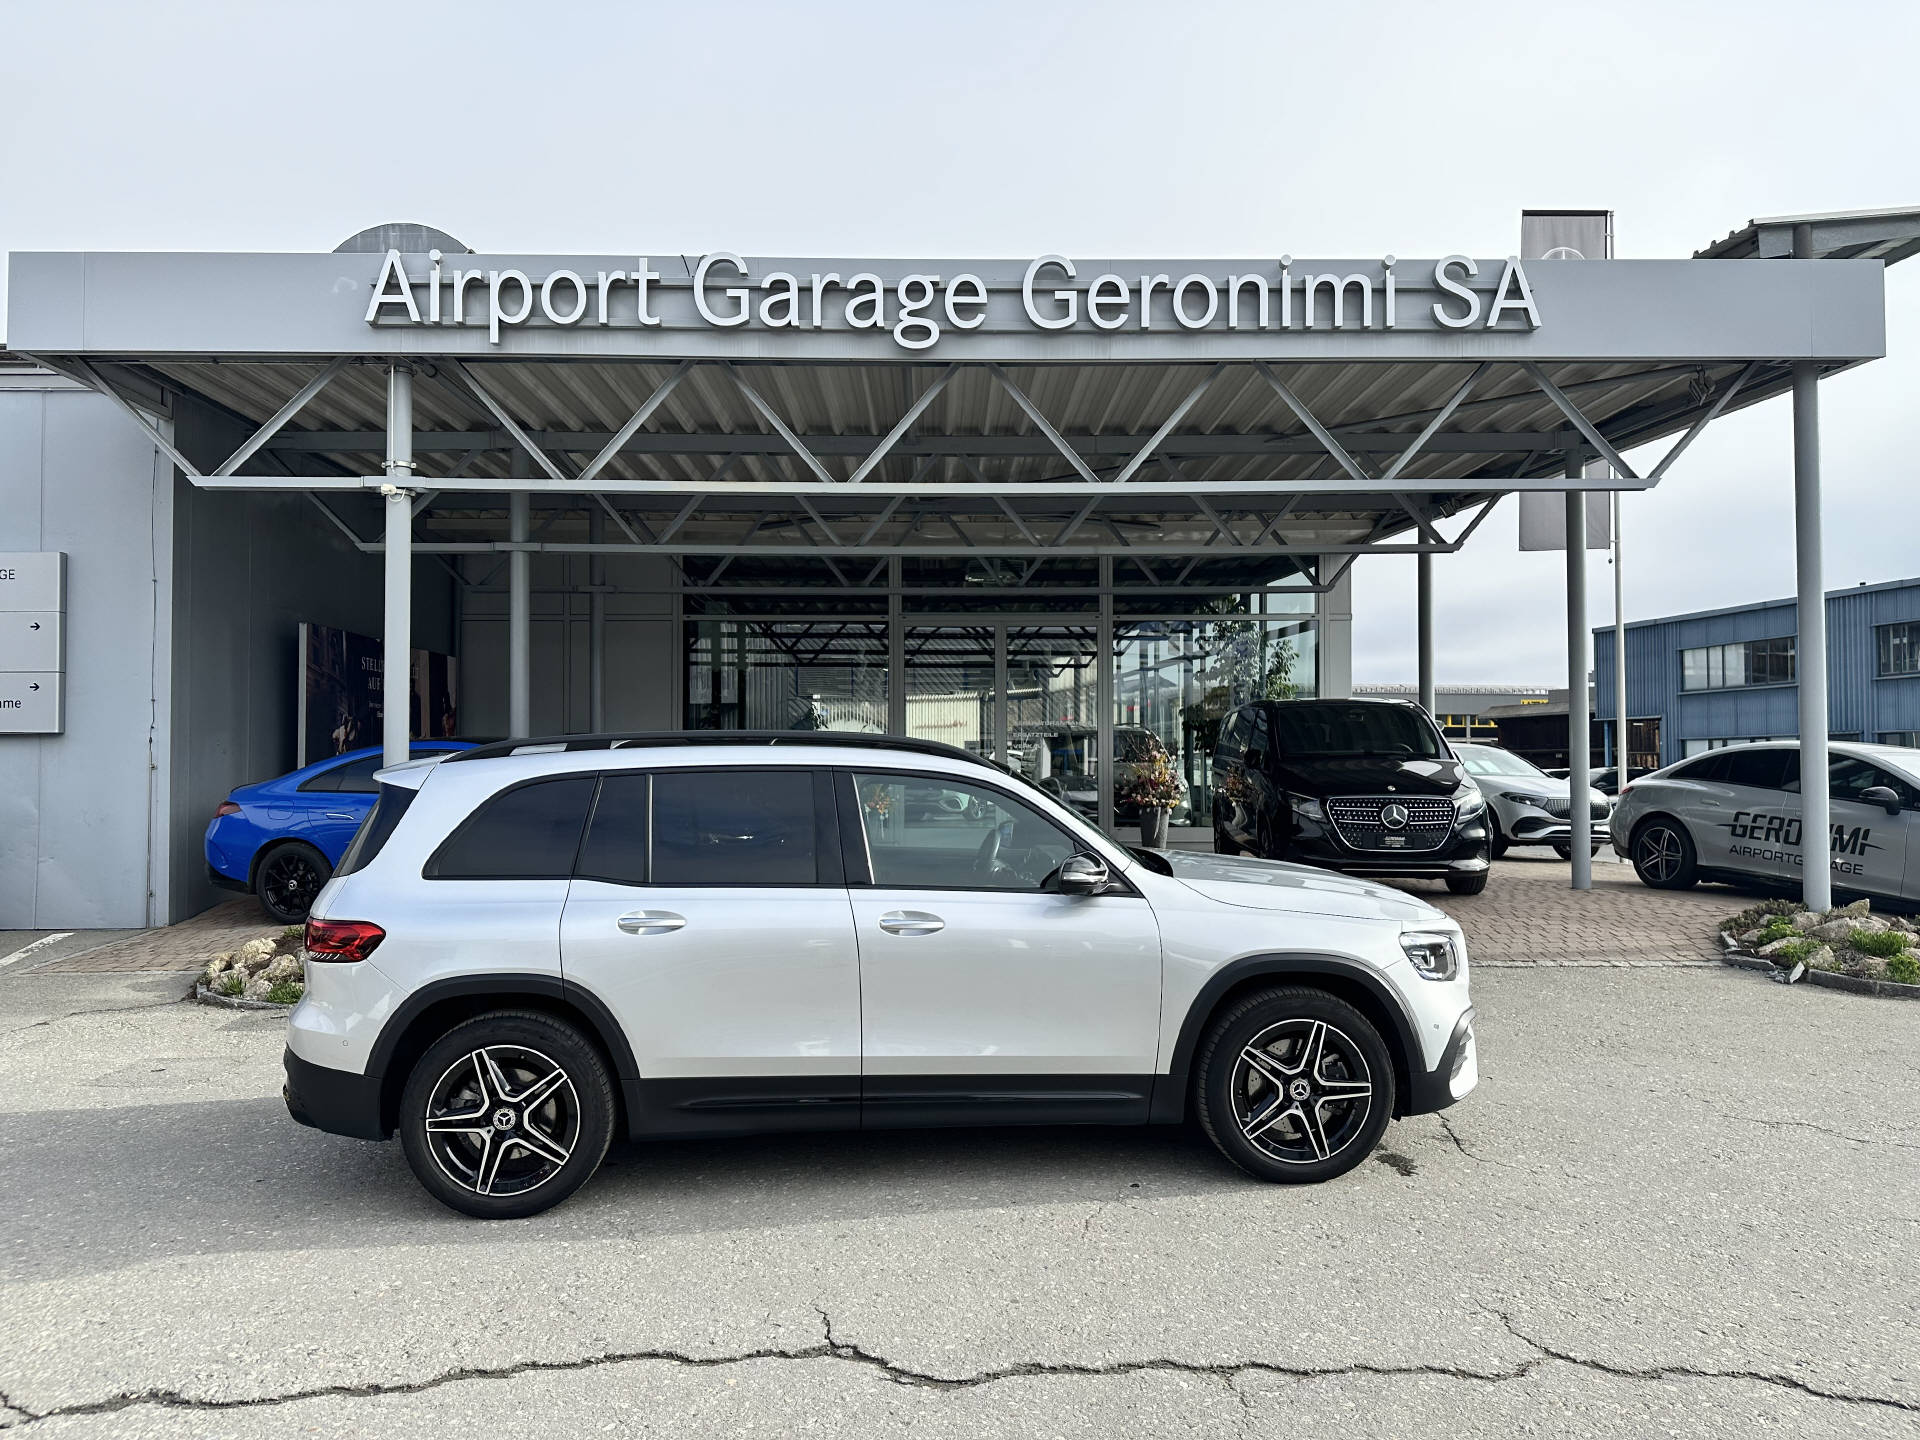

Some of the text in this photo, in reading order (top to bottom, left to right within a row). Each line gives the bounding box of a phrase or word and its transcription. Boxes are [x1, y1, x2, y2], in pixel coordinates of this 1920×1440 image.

[365, 248, 1542, 350] Airport Garage Geronimi SA
